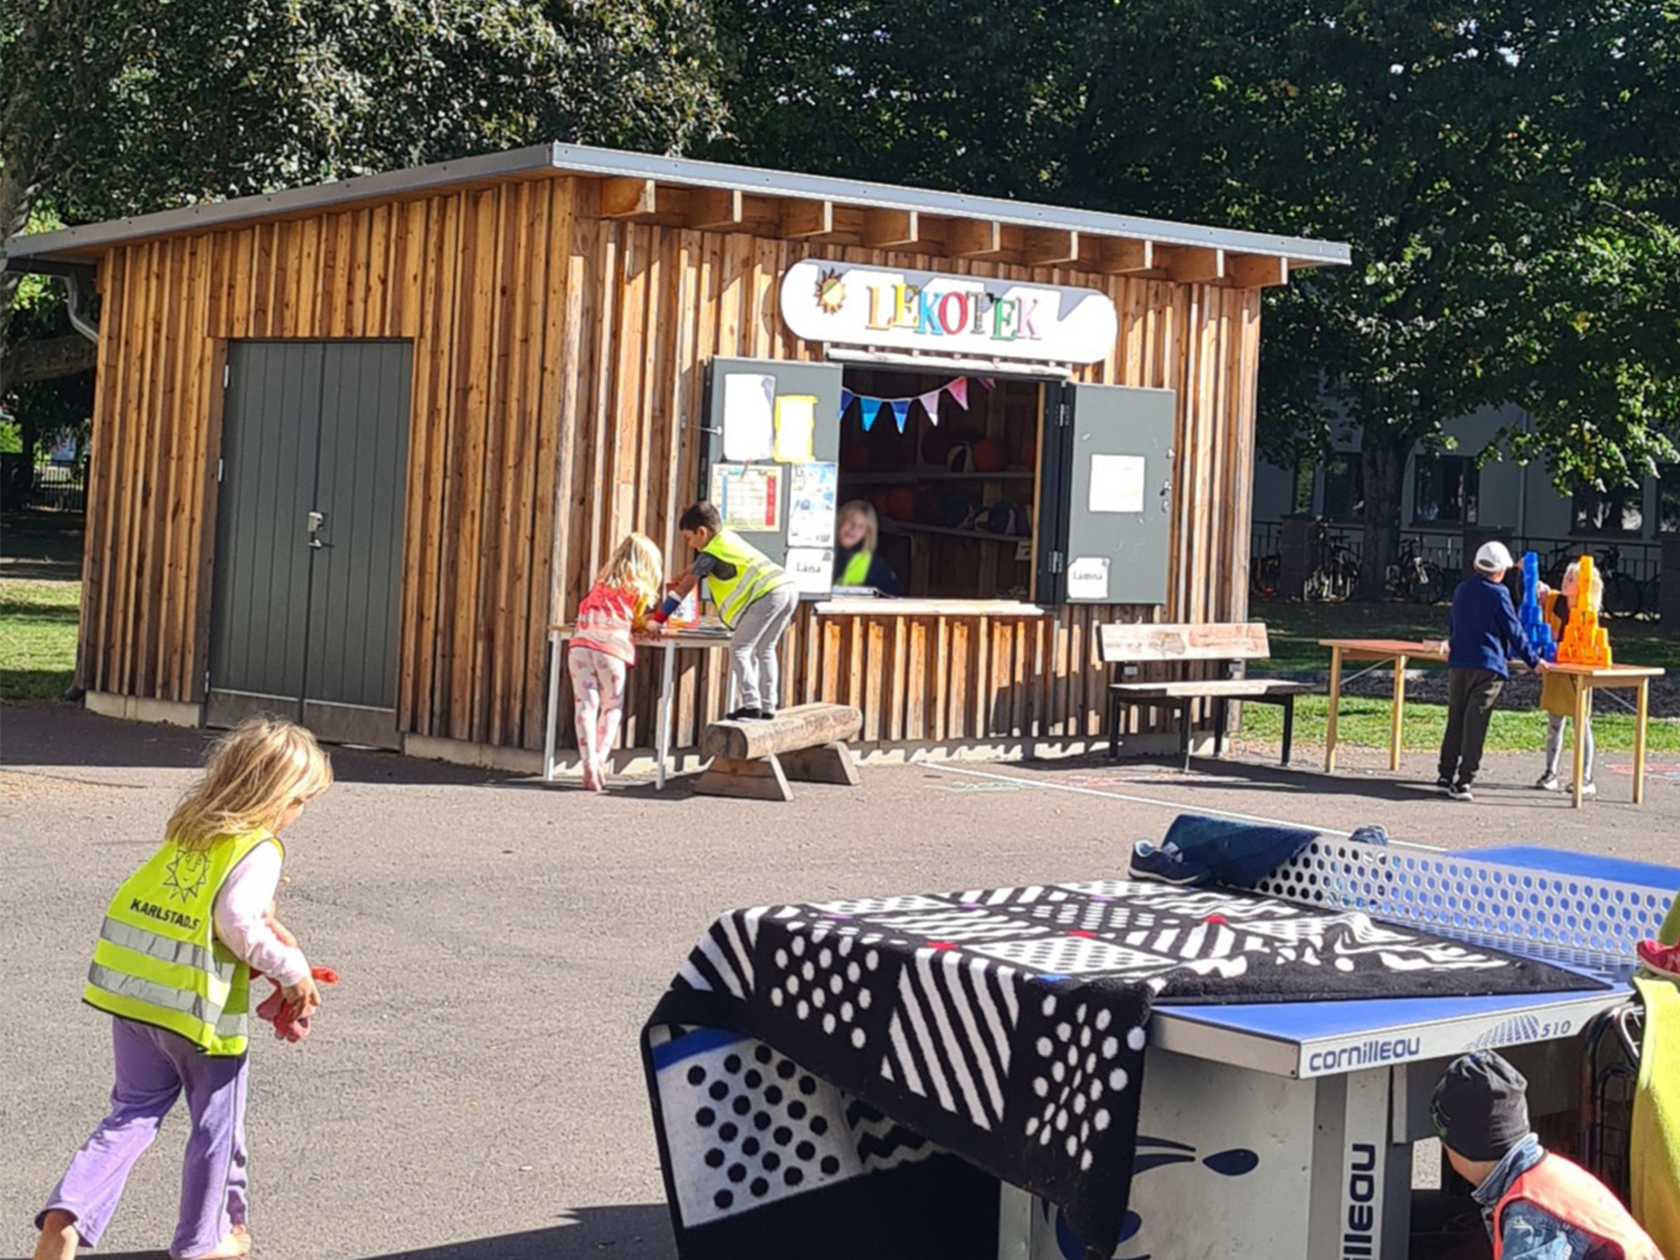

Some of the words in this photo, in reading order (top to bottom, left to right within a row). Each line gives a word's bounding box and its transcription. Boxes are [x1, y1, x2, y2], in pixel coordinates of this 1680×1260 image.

[865, 282, 1042, 342] LEKOTEK
[1540, 1020, 1572, 1038] 510
[1308, 1036, 1421, 1073] cornilleau
